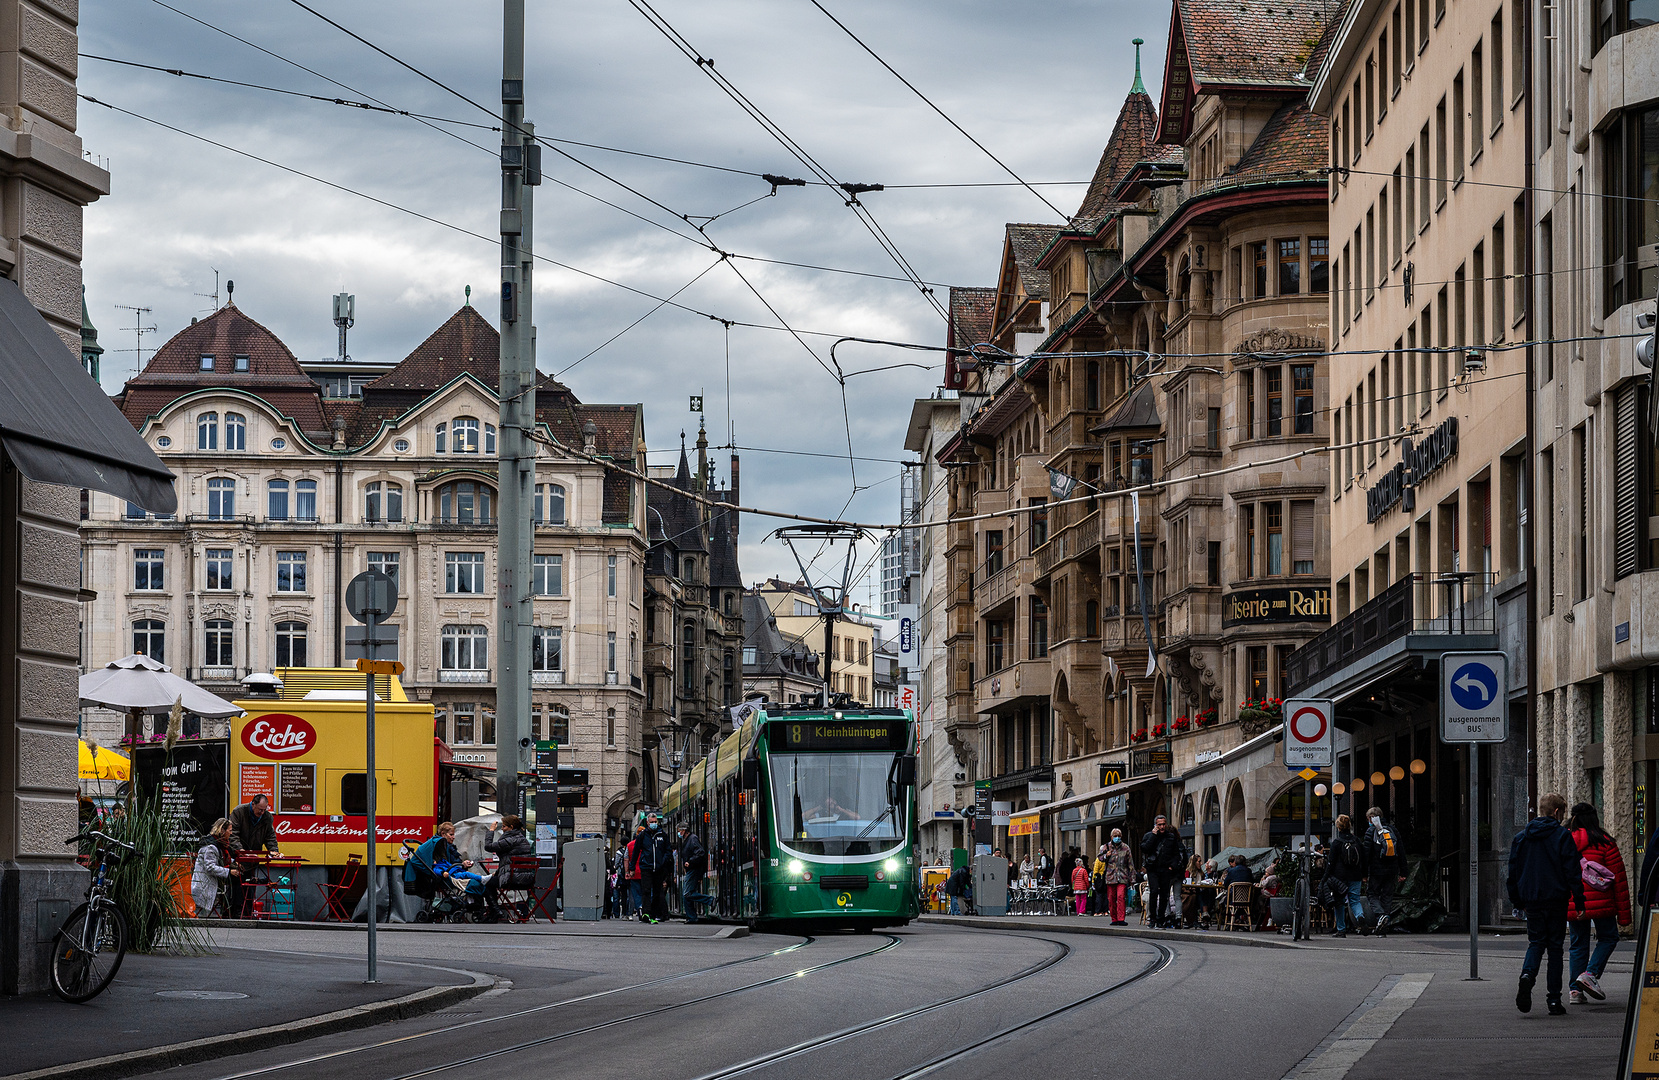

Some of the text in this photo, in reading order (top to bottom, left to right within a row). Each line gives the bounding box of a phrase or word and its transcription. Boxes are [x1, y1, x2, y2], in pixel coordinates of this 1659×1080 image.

[1272, 600, 1287, 608] zum
[902, 620, 910, 650] Berlitz
[1448, 716, 1500, 724] ausgenommen
[792, 724, 888, 743] 8 Kleinhüningen
[1467, 725, 1482, 733] BUS
[249, 720, 307, 753] Eiche
[181, 760, 197, 774] Grill
